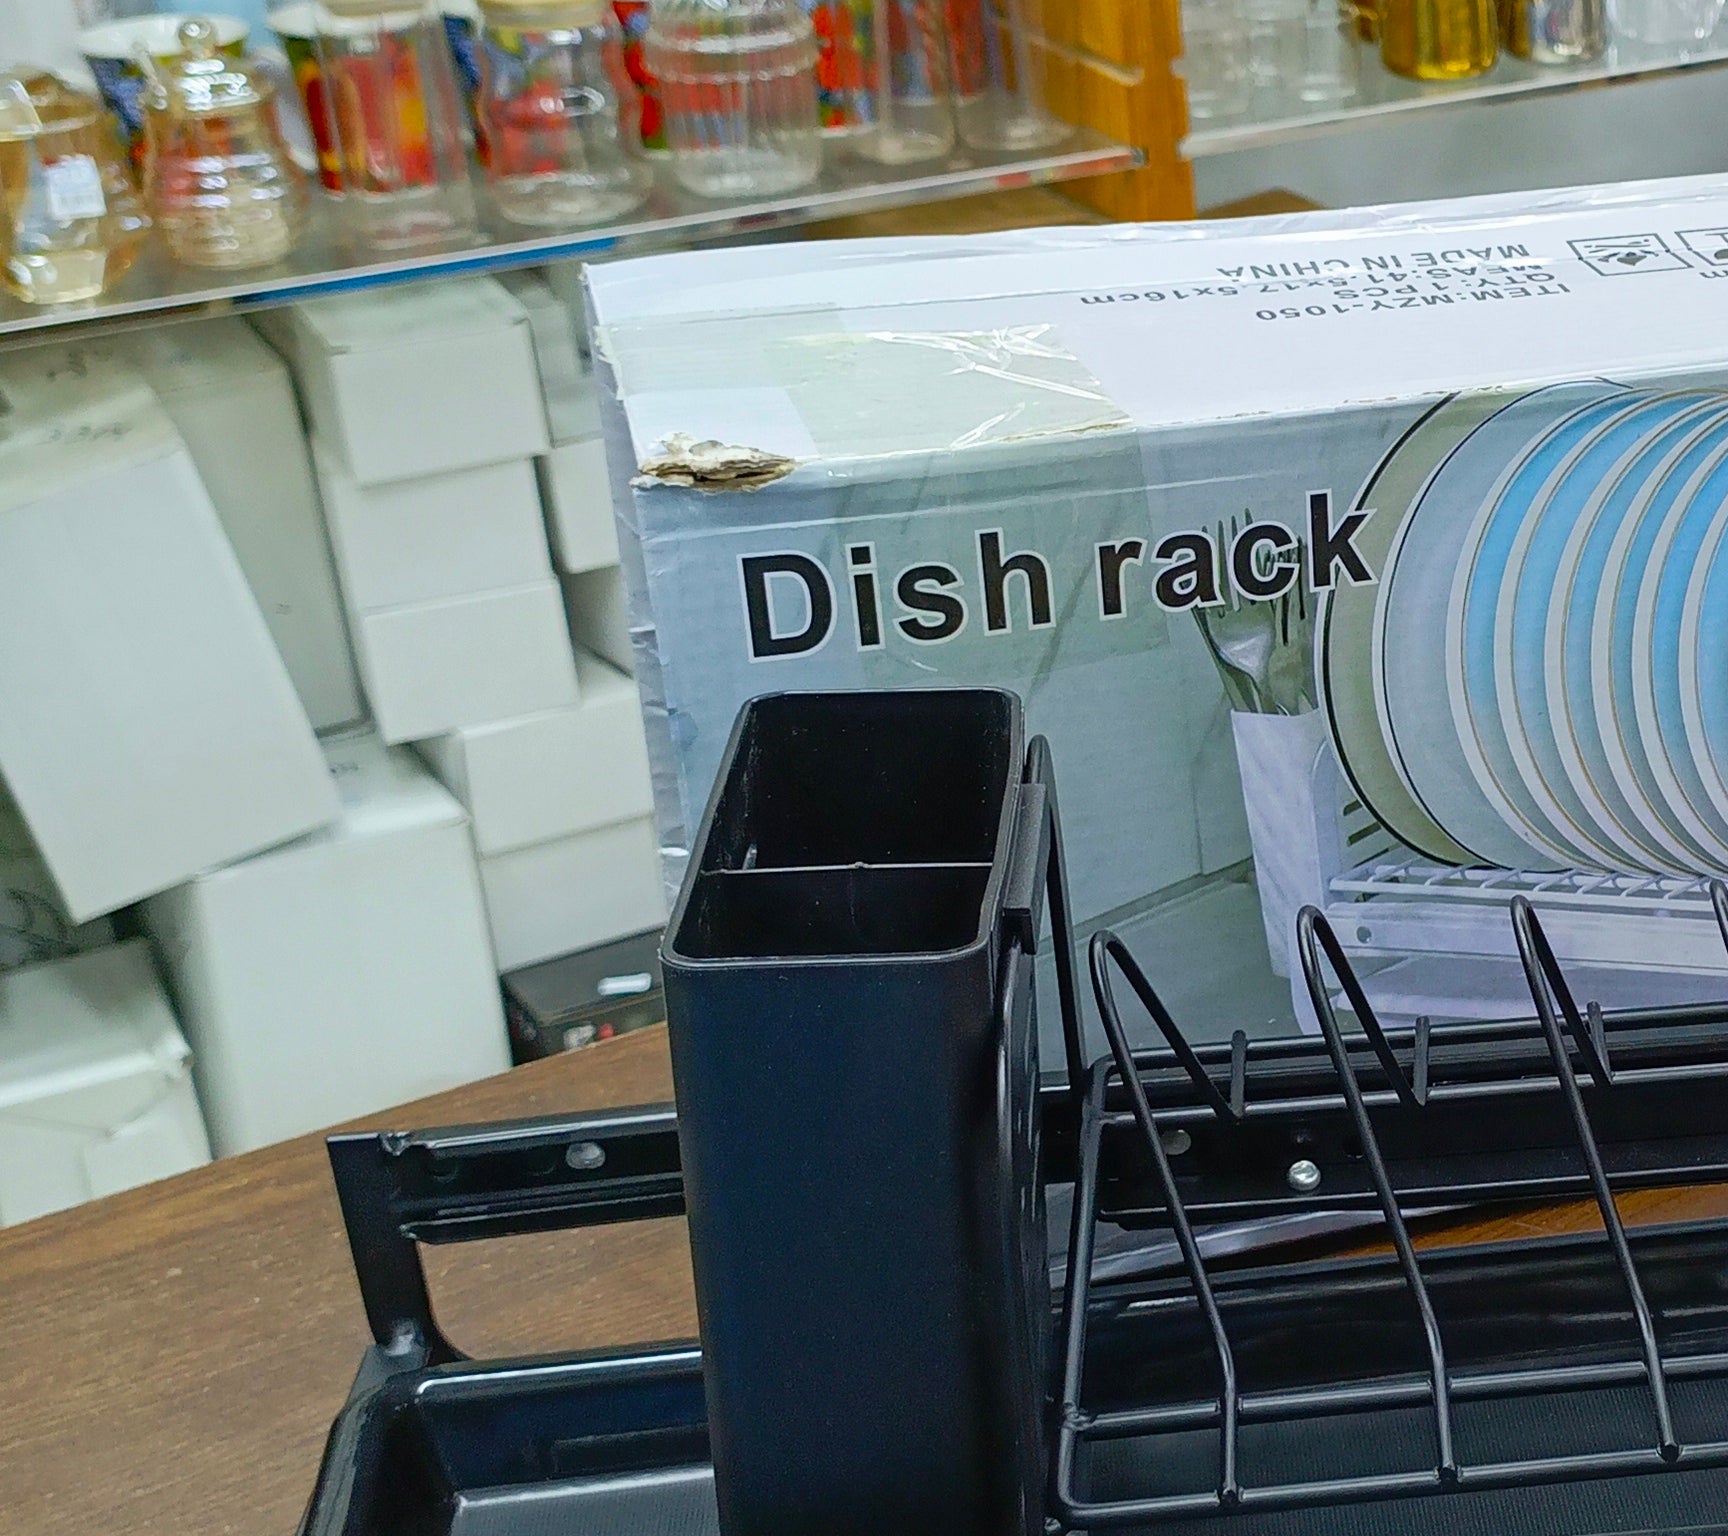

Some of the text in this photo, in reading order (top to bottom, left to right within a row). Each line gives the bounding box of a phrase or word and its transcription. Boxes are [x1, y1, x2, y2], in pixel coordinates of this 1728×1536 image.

[1216, 243, 1530, 283] MADE IN CHINA
[1464, 272, 1556, 288] QTY:
[1256, 282, 1571, 321] ITEM:MZY-1050
[1333, 284, 1419, 300] PCS
[737, 488, 1379, 663] Dish rack
